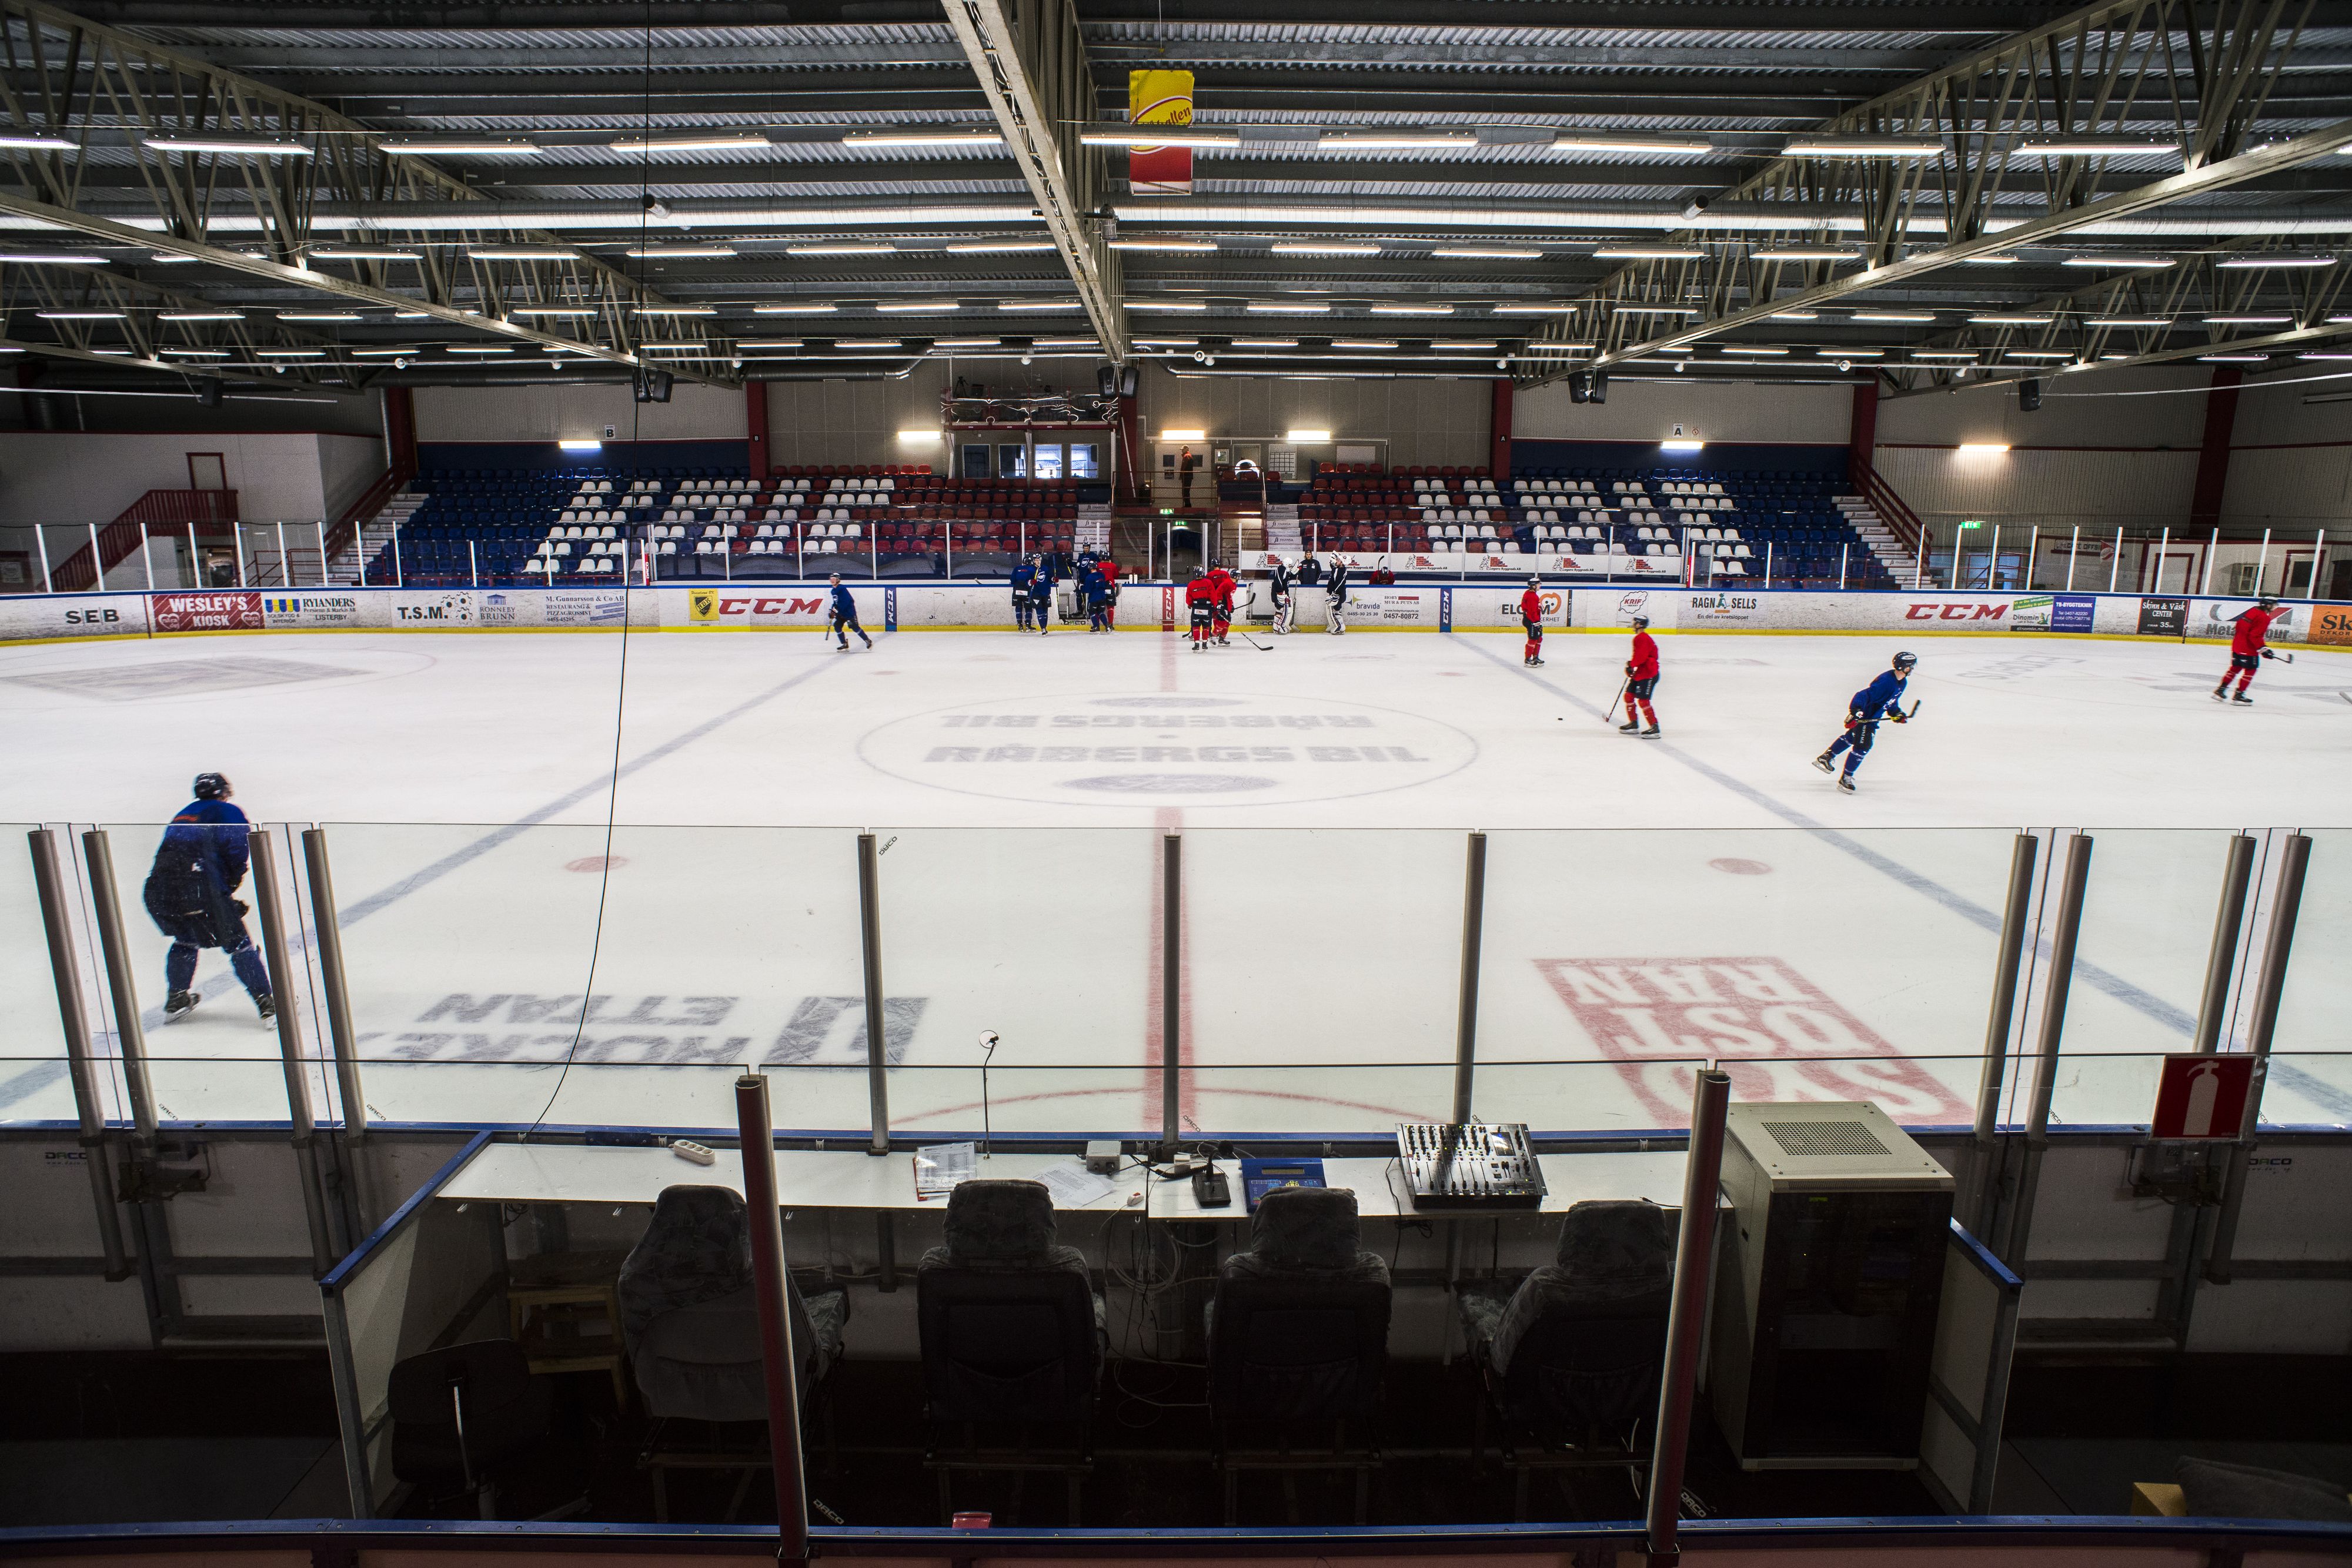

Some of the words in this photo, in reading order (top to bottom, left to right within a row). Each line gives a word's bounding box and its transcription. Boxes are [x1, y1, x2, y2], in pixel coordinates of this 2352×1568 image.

[606, 429, 614, 437] B
[1674, 427, 1682, 436] A
[169, 596, 248, 612] WESLEY'S
[697, 597, 711, 610] HBK
[719, 598, 823, 615] CCM
[1502, 604, 1550, 614] ELCM
[1731, 598, 1757, 609] SELLS
[2142, 600, 2160, 610] Skinn
[2169, 601, 2185, 611] Väsk
[65, 609, 119, 624] SEB
[397, 606, 449, 620] T.S.M.
[1905, 604, 2009, 620] CCM
[193, 615, 230, 627] KIOSK
[923, 742, 1291, 763] RÅBERGS
[1308, 746, 1430, 763] BIL
[414, 994, 739, 1025] ETTAN
[1183, 1114, 1201, 1132] DACO
